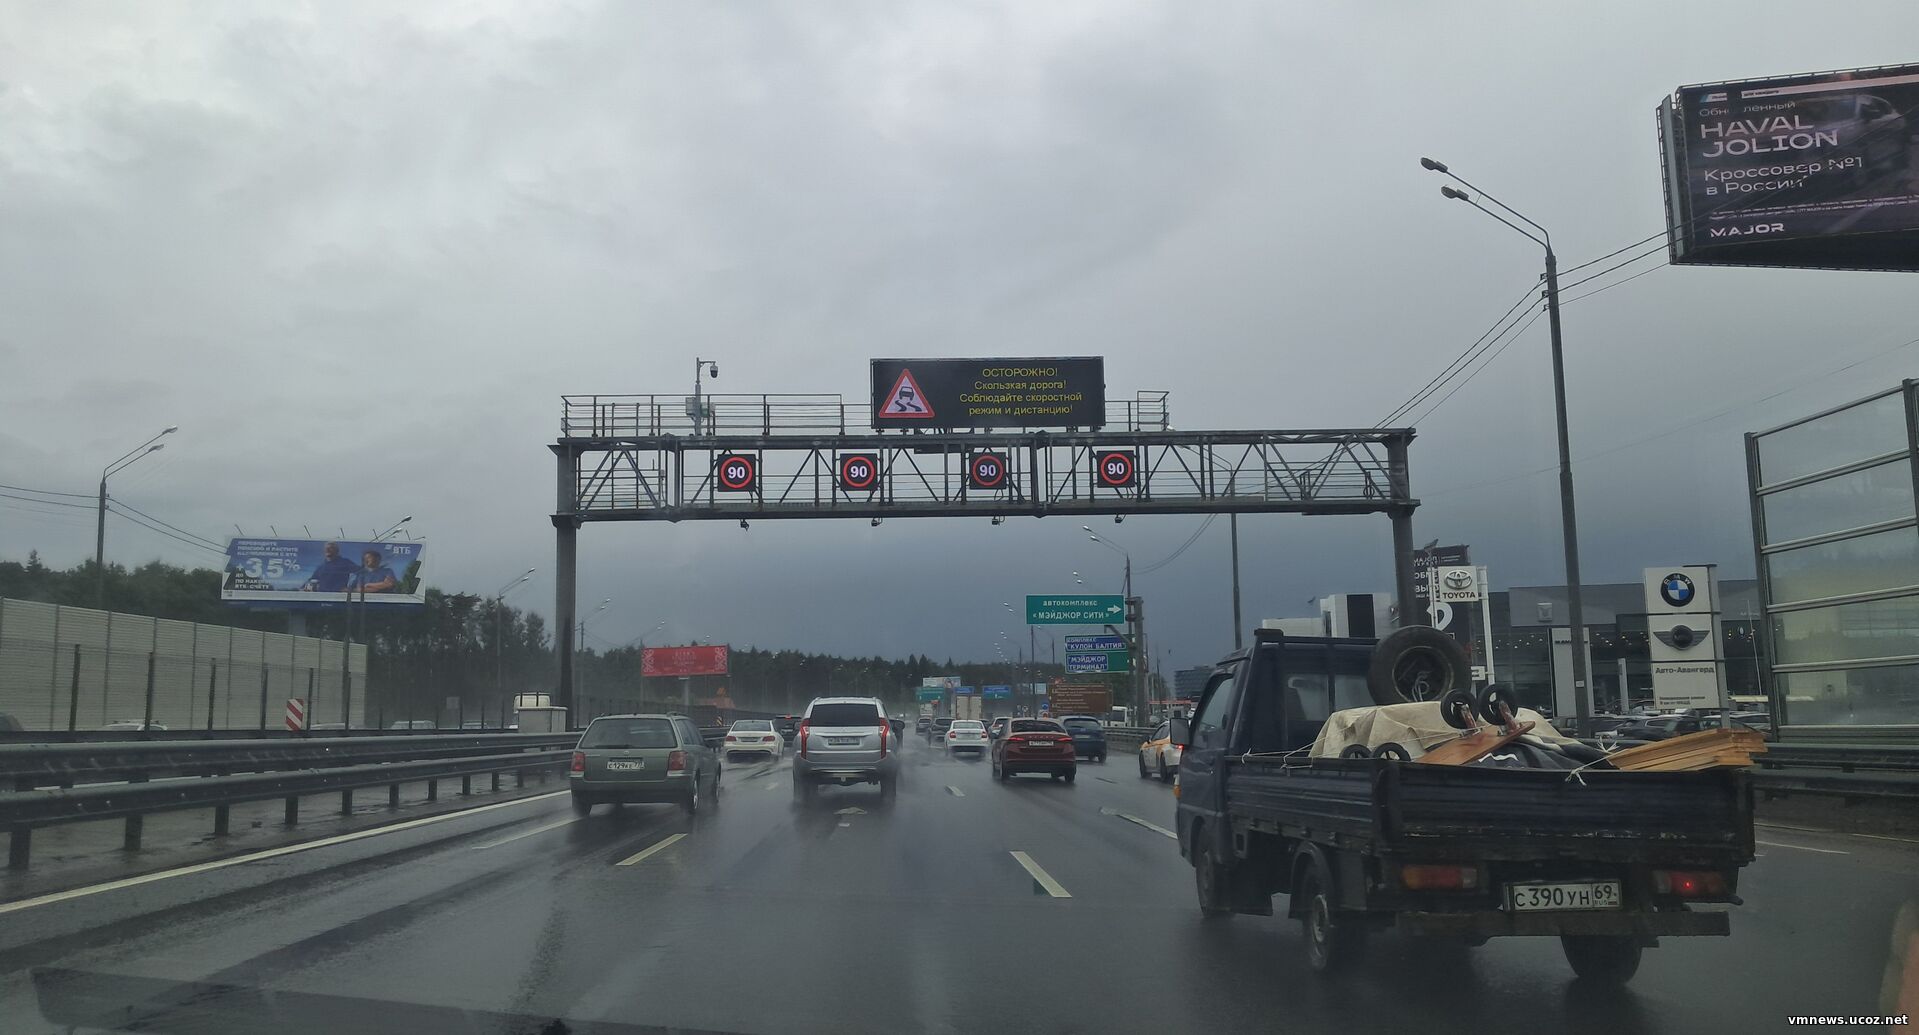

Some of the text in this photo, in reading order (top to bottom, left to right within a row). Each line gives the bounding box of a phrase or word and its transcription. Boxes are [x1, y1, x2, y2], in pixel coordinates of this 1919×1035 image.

[1701, 115, 1814, 138] HAVAL
[1702, 129, 1839, 157] JOLION
[1706, 187, 1718, 196] в
[1710, 223, 1784, 237] MAJOR
[982, 368, 1058, 377] ОСТОРОЖНО!
[974, 380, 1067, 390] Скользкая дорога!
[960, 392, 1082, 403] Соблюдайте скоростной
[969, 407, 1001, 416] режим
[1013, 405, 1073, 415] дистанцию!
[727, 466, 745, 478] 90
[850, 465, 868, 477] 90
[979, 464, 996, 476] 90
[1107, 462, 1124, 475] 90
[393, 546, 410, 554] ВТБ
[1443, 591, 1476, 600] TOYOTA
[1514, 884, 1613, 907] С390УН 69
